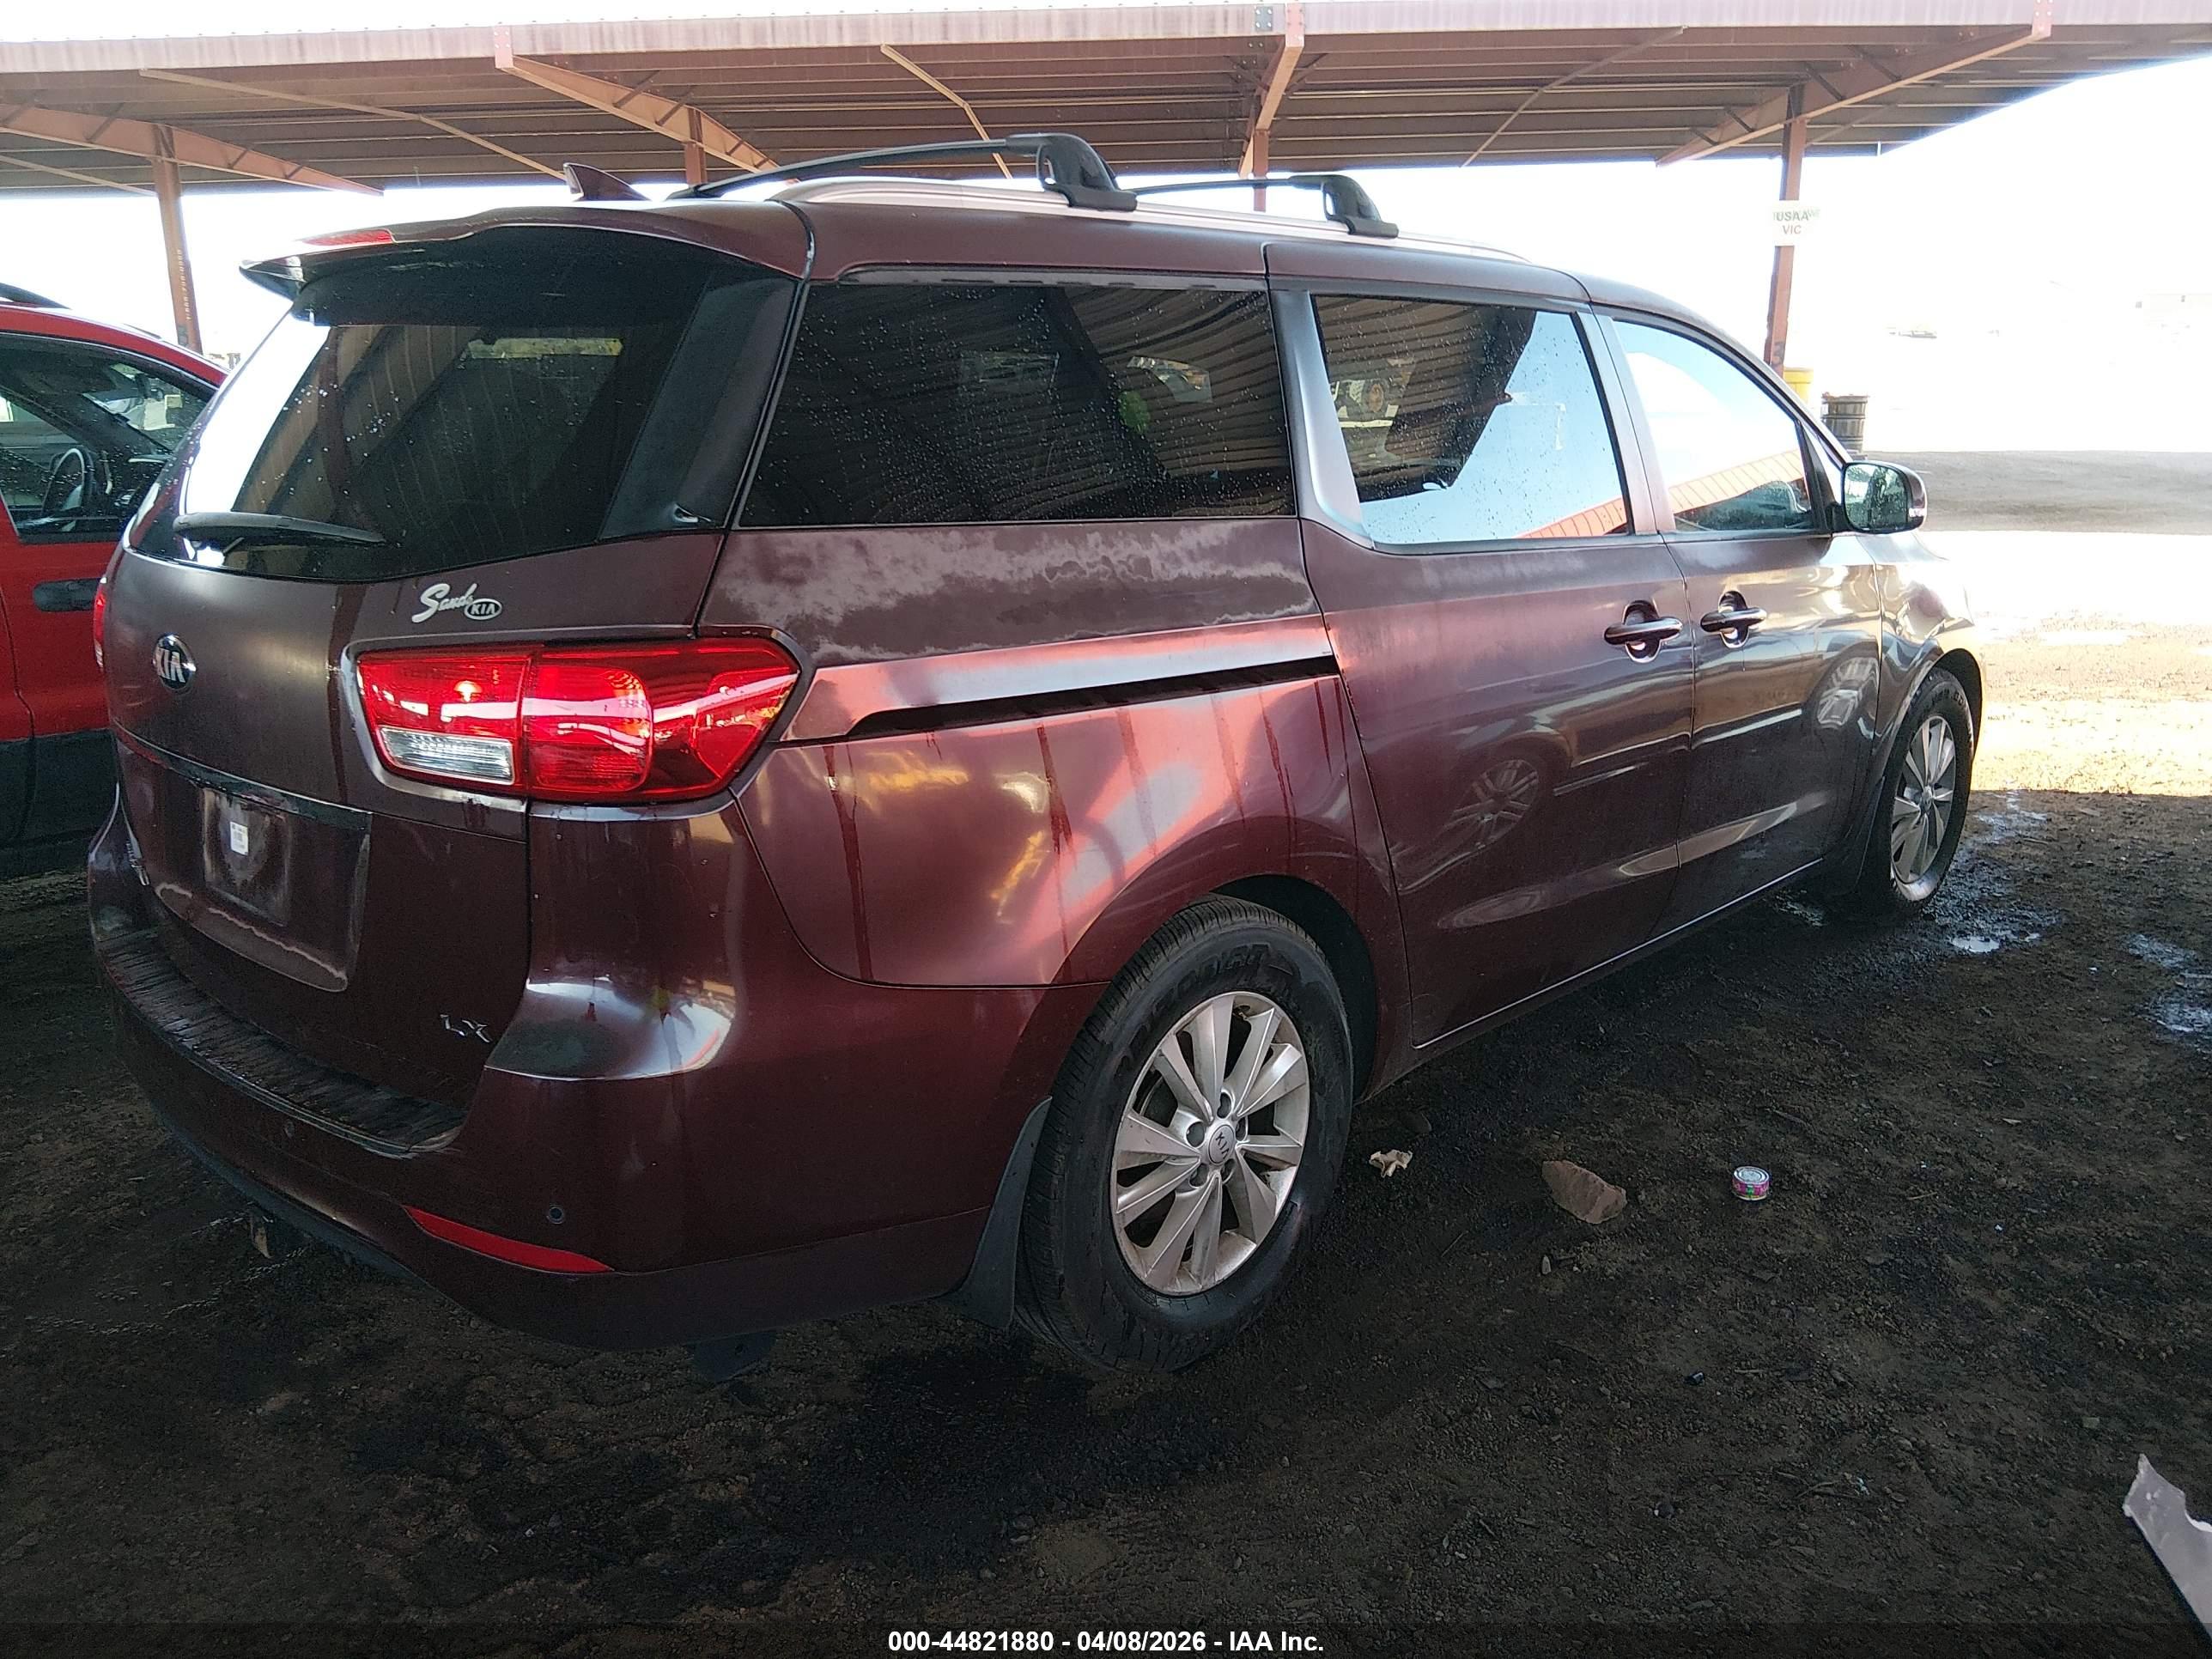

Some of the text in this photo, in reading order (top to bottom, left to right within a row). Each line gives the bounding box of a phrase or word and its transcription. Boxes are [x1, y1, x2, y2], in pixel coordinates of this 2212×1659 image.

[1775, 210, 1809, 222] USAA
[1782, 224, 1802, 234] VIC
[155, 646, 186, 684] KIA
[440, 1014, 492, 1043] LX
[1215, 1131, 1231, 1160] KIA
